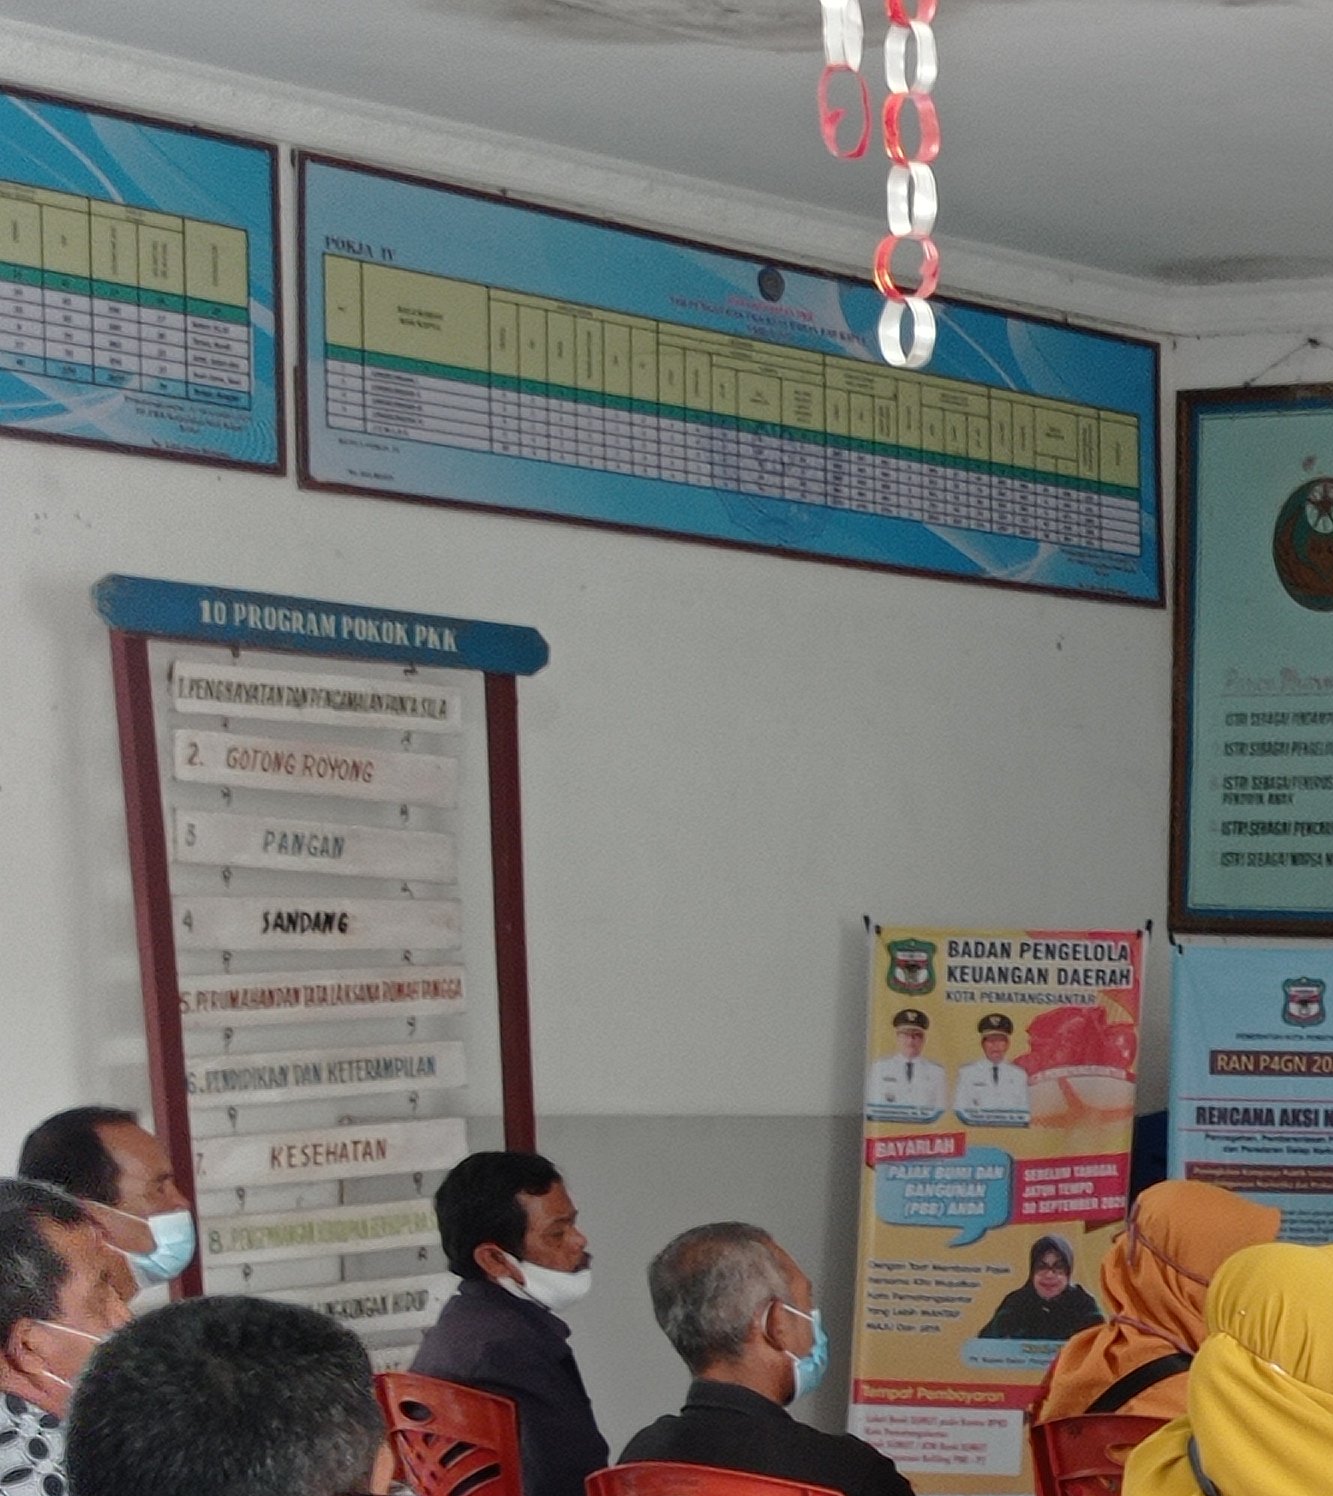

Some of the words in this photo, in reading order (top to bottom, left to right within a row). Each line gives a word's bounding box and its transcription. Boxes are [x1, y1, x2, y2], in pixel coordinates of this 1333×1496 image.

[200, 600, 226, 626] 10
[231, 602, 337, 637] PROGRAM
[342, 615, 408, 643] POKOK
[414, 625, 459, 652] PKK
[226, 746, 297, 777] GOTONG
[300, 753, 375, 785] ROYONG
[263, 828, 346, 859] PANGAN
[261, 909, 350, 935] SANDANG
[947, 939, 1012, 960] BADAN
[1019, 941, 1129, 962] PENGELOLA
[946, 964, 1049, 986] KEUANGAN
[1056, 967, 1131, 987] DAERAH
[946, 991, 977, 1004] KOTA
[979, 991, 1097, 1005] PEMATANGSIANTAR
[1216, 1053, 1255, 1071] RAN
[1259, 1054, 1307, 1073] P4GN
[1196, 1105, 1276, 1127] RENCANA
[1278, 1106, 1320, 1128] AKSI
[269, 1138, 389, 1170] KESEHATAN
[874, 1138, 956, 1158] BAYARLAH
